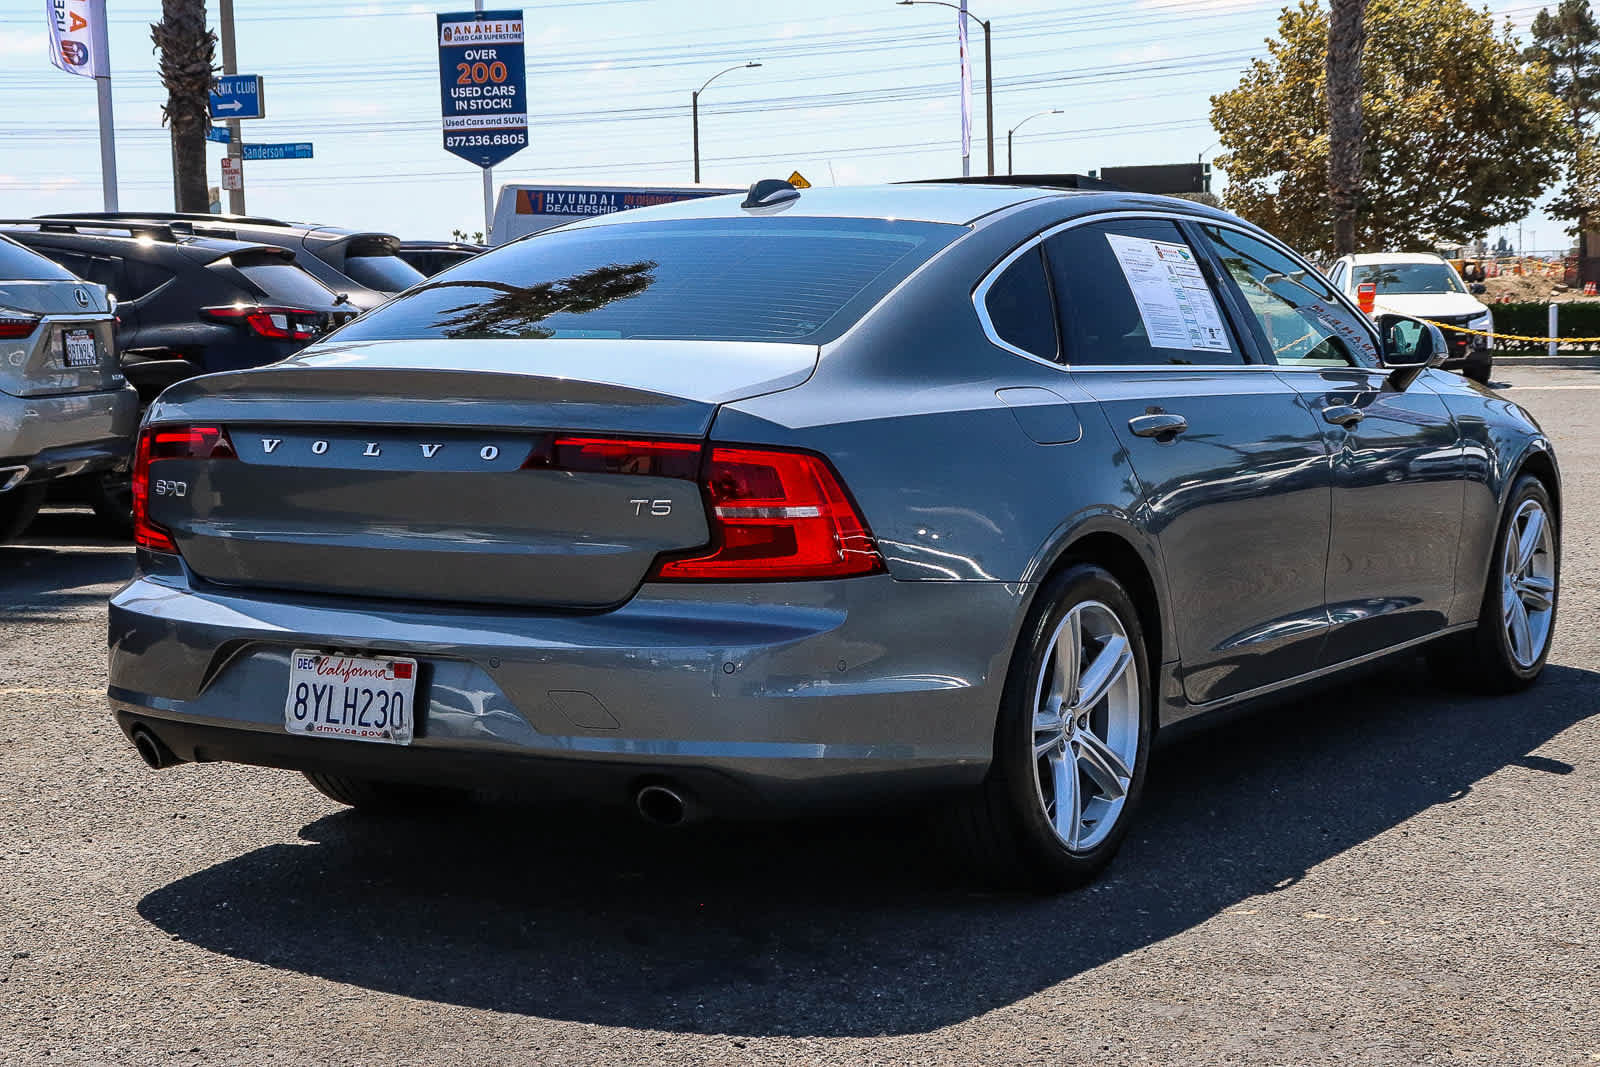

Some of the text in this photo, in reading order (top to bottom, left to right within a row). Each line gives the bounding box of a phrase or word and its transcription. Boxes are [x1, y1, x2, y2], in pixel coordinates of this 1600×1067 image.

[454, 23, 522, 35] ANAHEIM
[483, 33, 522, 41] SUPERSTORE
[464, 49, 497, 60] OVER
[456, 61, 508, 85] 200
[236, 81, 256, 94] CLUB
[450, 85, 516, 98] USED CARS
[455, 99, 512, 111] IN STOCK!
[445, 119, 465, 127] Used
[466, 118, 484, 126] Cars
[485, 117, 502, 125] and
[446, 134, 525, 147] 877.336.6805
[243, 145, 285, 159] Sanderson
[546, 193, 615, 205] HYUNDAI
[546, 204, 618, 214] DEALERSHIP
[261, 438, 500, 460] VOLVO
[155, 480, 188, 497] S90
[630, 499, 672, 516] T5
[297, 657, 314, 670] DEC
[317, 656, 394, 683] California
[293, 682, 404, 730] 8YLH230
[316, 725, 383, 737] dmv.ca.gov
